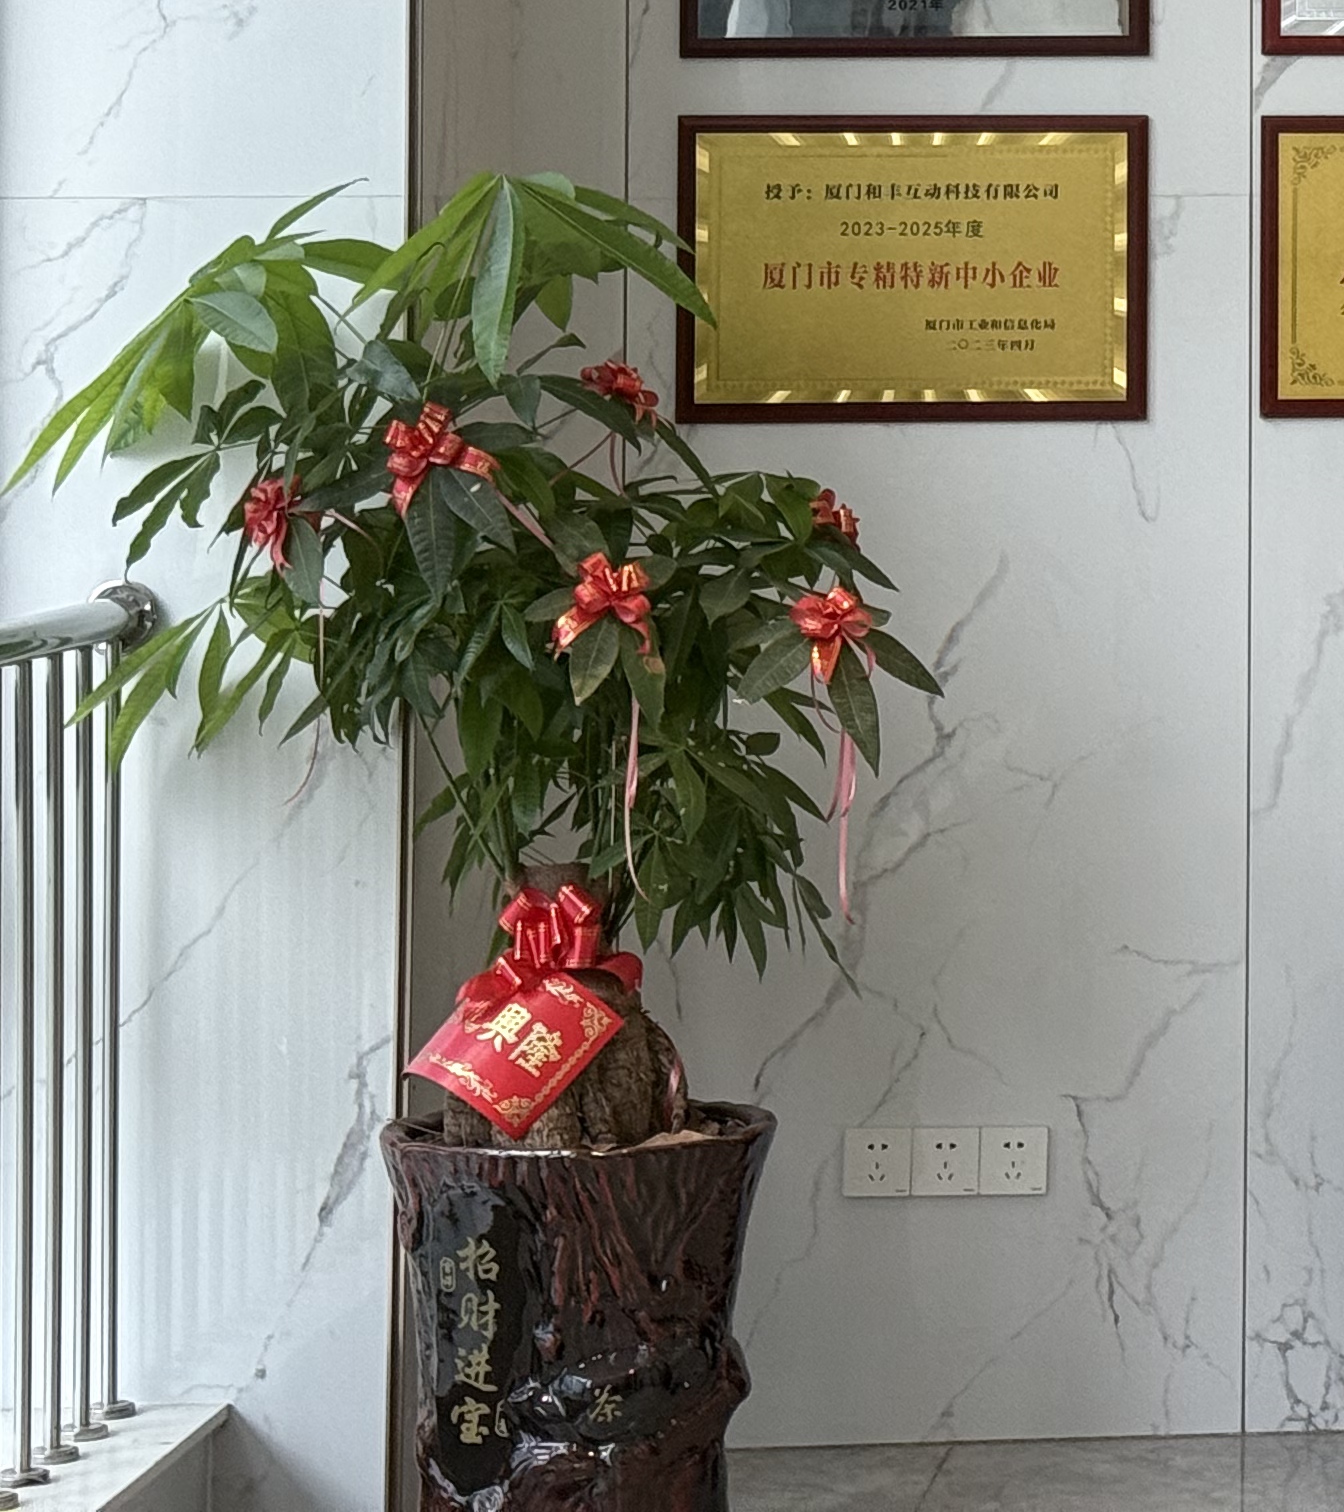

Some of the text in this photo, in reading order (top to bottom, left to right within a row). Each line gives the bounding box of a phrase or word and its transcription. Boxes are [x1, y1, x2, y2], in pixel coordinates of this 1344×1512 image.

[839, 219, 984, 239] 2023-2025年度
[762, 261, 1061, 291] 厦门市专精特新中小企业
[924, 317, 1056, 332] 厦门市工业和信息化局
[450, 1237, 501, 1444] 招财进宝
